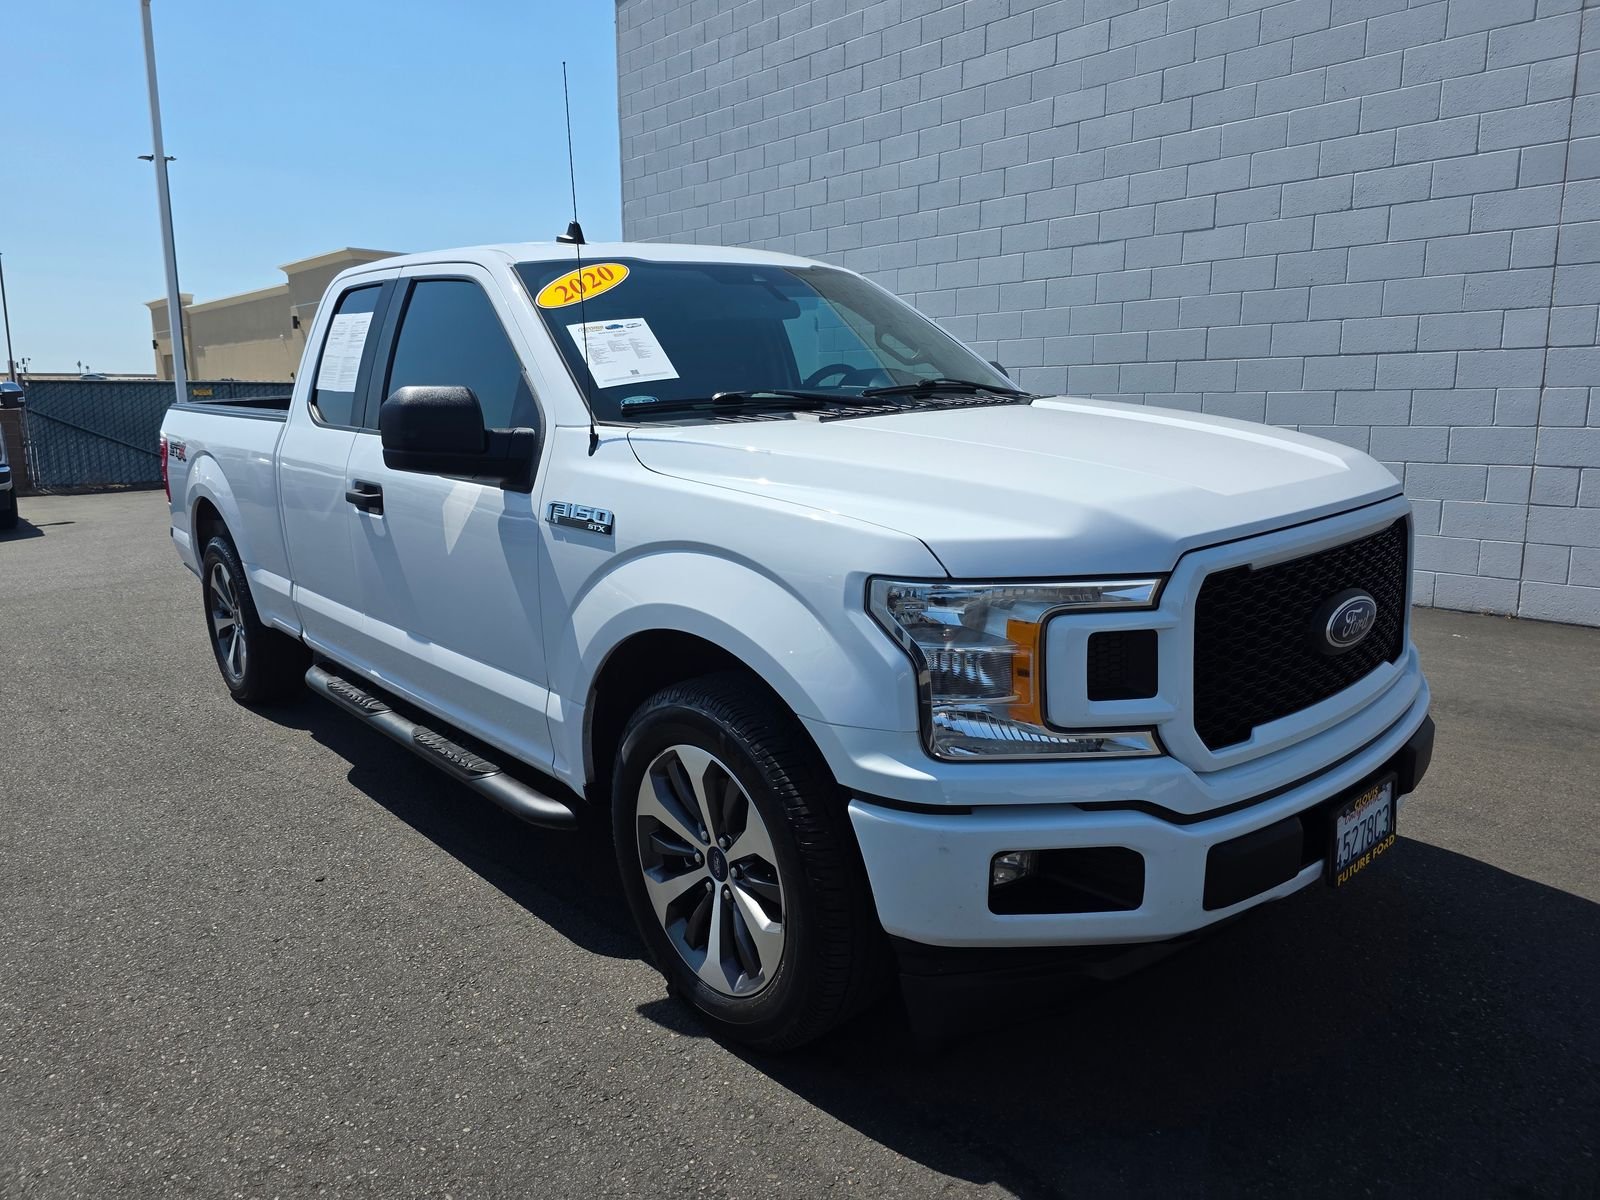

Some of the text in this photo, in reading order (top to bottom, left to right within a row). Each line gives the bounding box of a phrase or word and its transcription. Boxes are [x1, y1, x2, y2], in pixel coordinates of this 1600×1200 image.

[554, 266, 615, 303] 2020
[587, 523, 606, 533] STX
[1342, 607, 1370, 638] Ford
[1354, 786, 1379, 810] CLOVIS
[1337, 834, 1396, 887] FUTURE FORD
